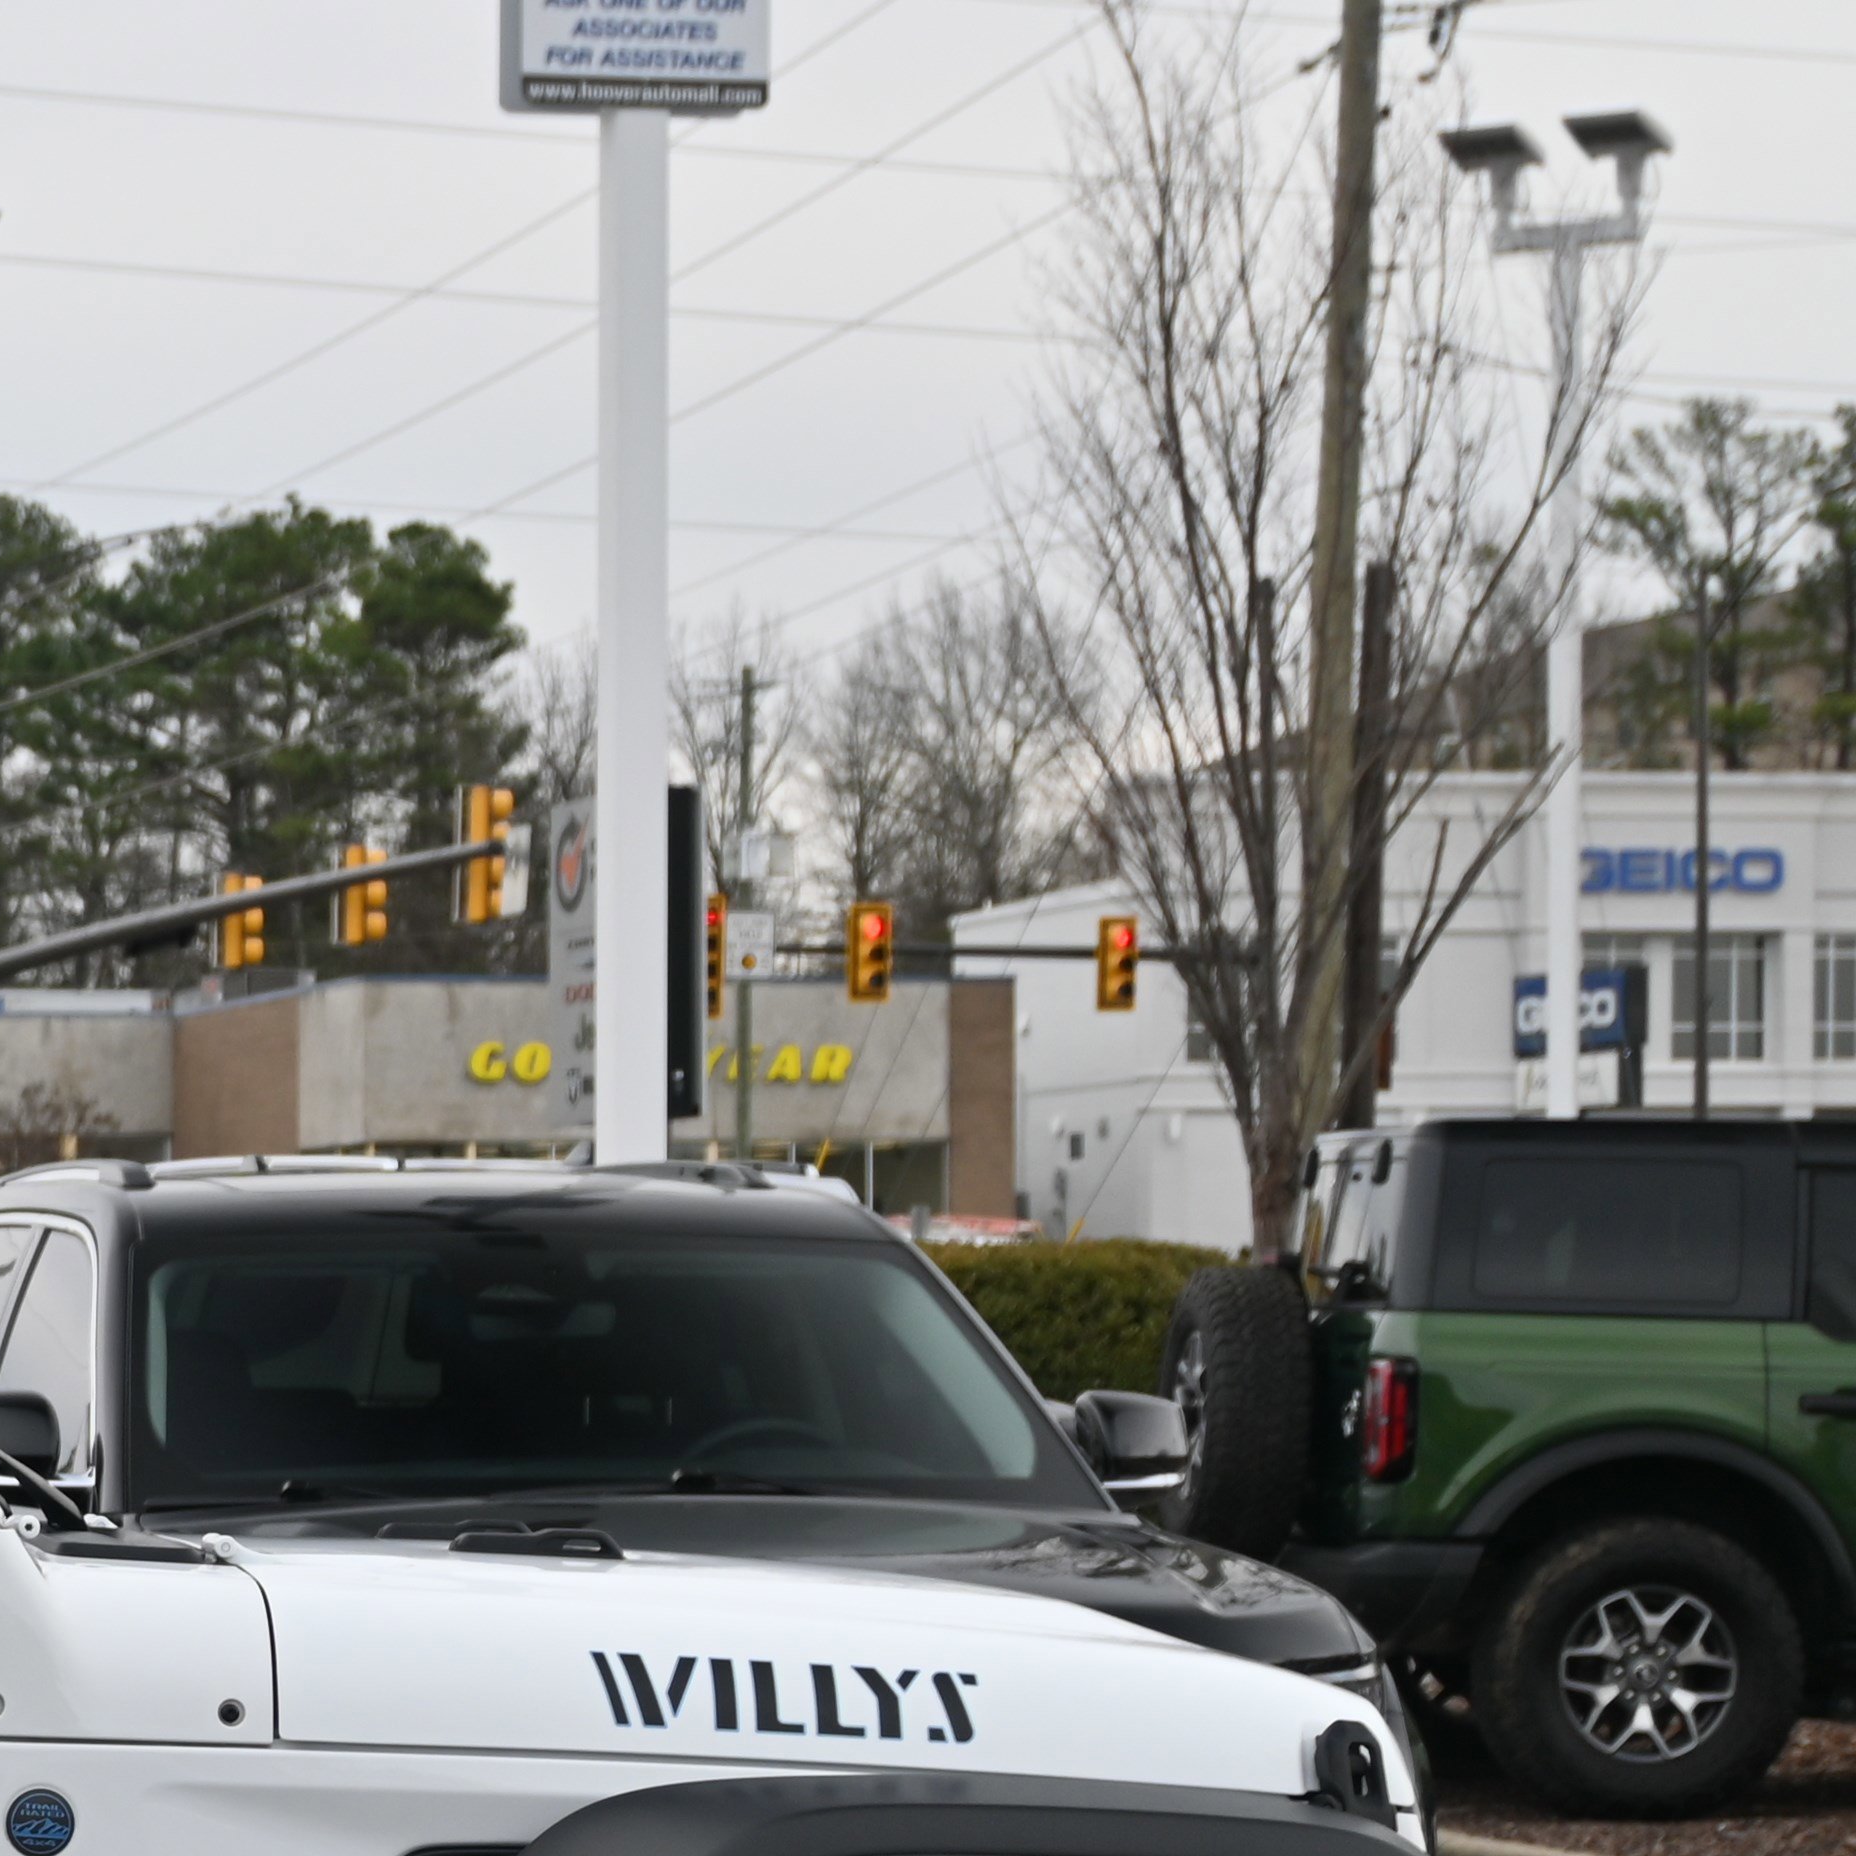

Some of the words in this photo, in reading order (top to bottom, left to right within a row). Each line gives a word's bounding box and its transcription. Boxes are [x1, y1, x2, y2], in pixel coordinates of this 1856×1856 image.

[572, 17, 719, 40] ASSOCIATES
[545, 46, 593, 65] FOR
[599, 48, 746, 70] ASSISTANCE
[528, 80, 763, 104] www.hooverautomall.com
[1580, 847, 1784, 892] GEICO
[589, 1650, 978, 1744] WILLYS
[19, 1808, 66, 1818] RATED
[24, 1801, 59, 1811] TRAIL
